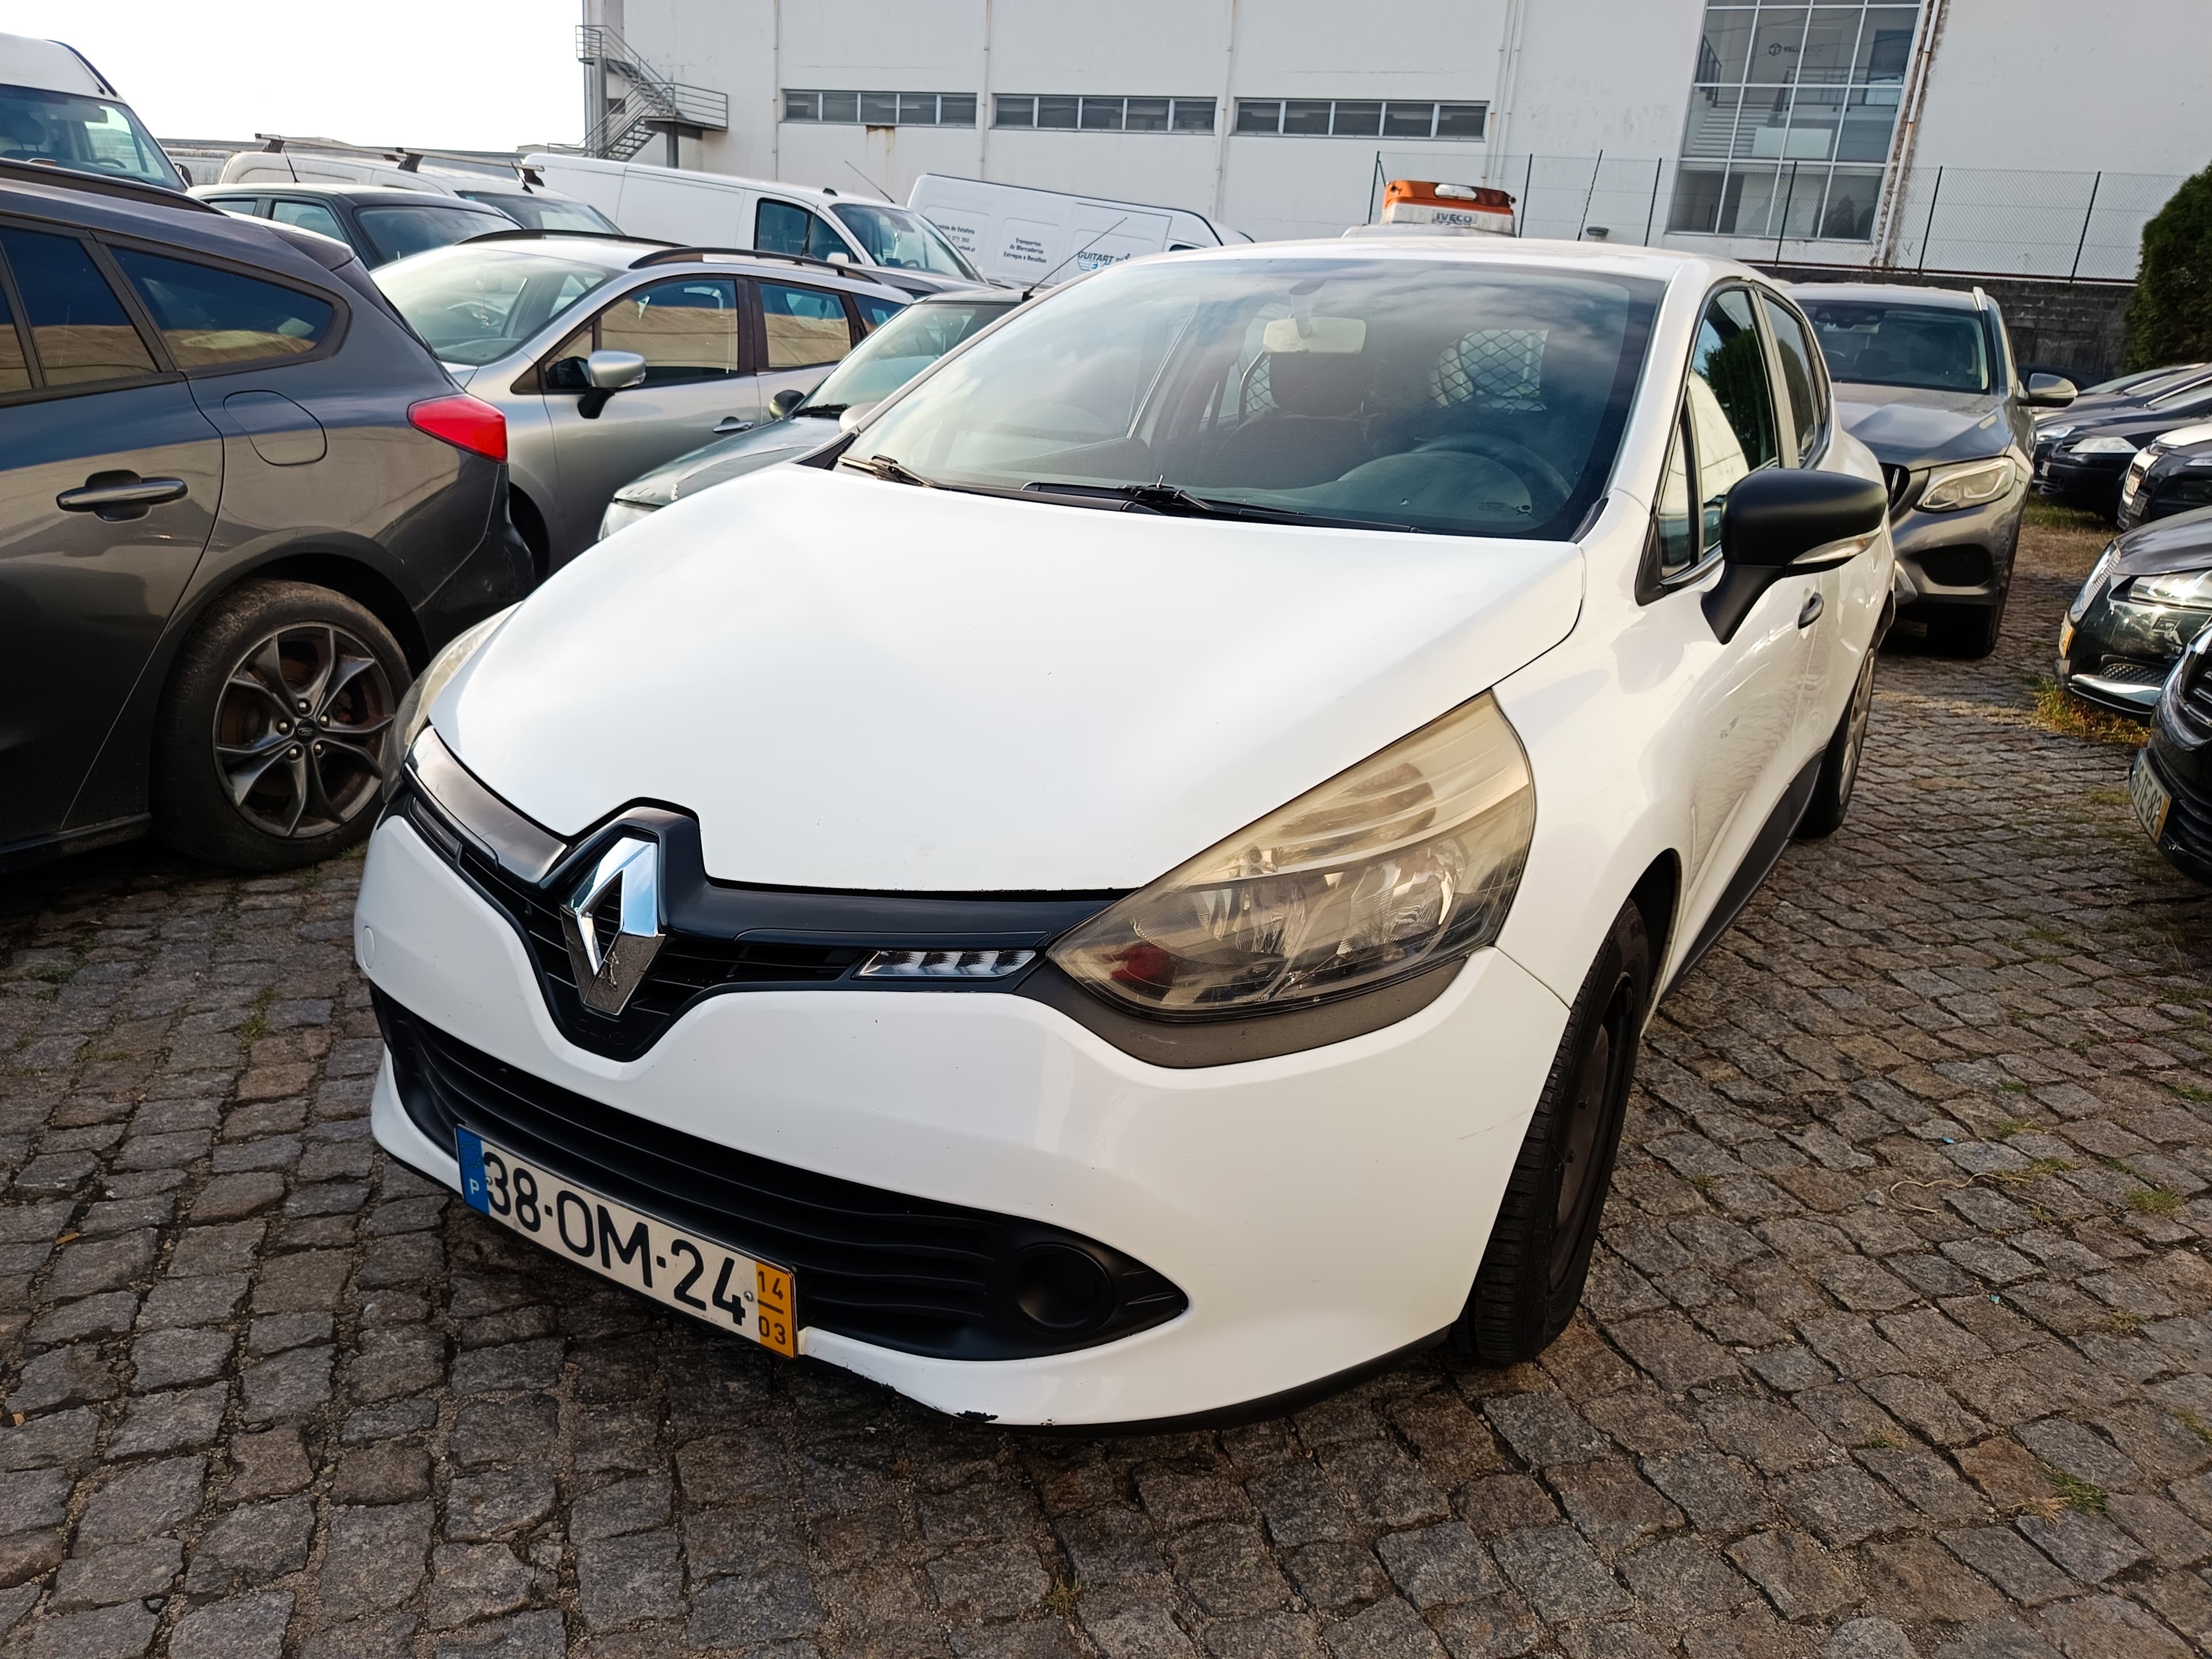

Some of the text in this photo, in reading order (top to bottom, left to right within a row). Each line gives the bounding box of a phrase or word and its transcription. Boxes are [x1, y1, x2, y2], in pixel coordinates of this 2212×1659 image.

[1436, 212, 1472, 224] IVECO
[1077, 252, 1115, 264] GUITART
[469, 1177, 480, 1195] P
[758, 1271, 784, 1301] 14
[759, 1315, 786, 1346] 03
